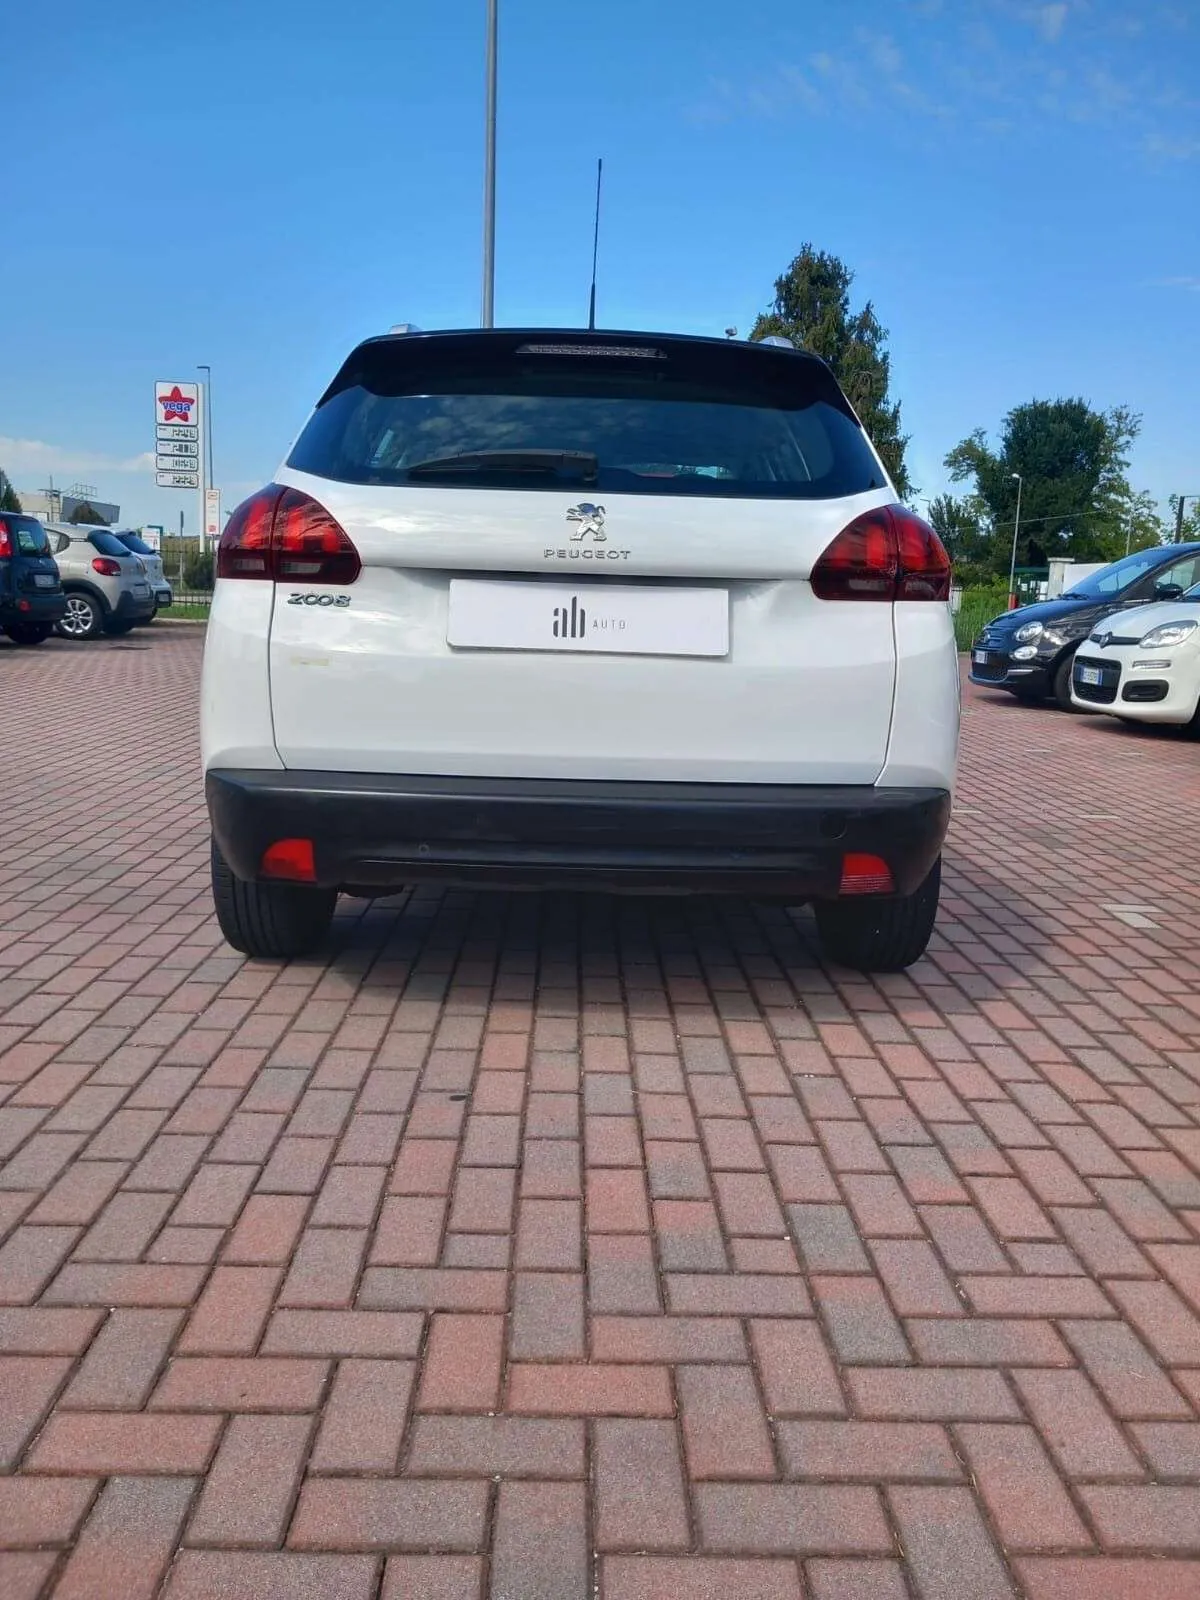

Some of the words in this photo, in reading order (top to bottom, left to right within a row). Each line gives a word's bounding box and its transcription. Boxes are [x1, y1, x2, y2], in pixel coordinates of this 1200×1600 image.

[163, 401, 192, 414] vega
[544, 549, 631, 560] PEUGEOT
[287, 593, 352, 607] 2008
[592, 619, 626, 630] AUTO
